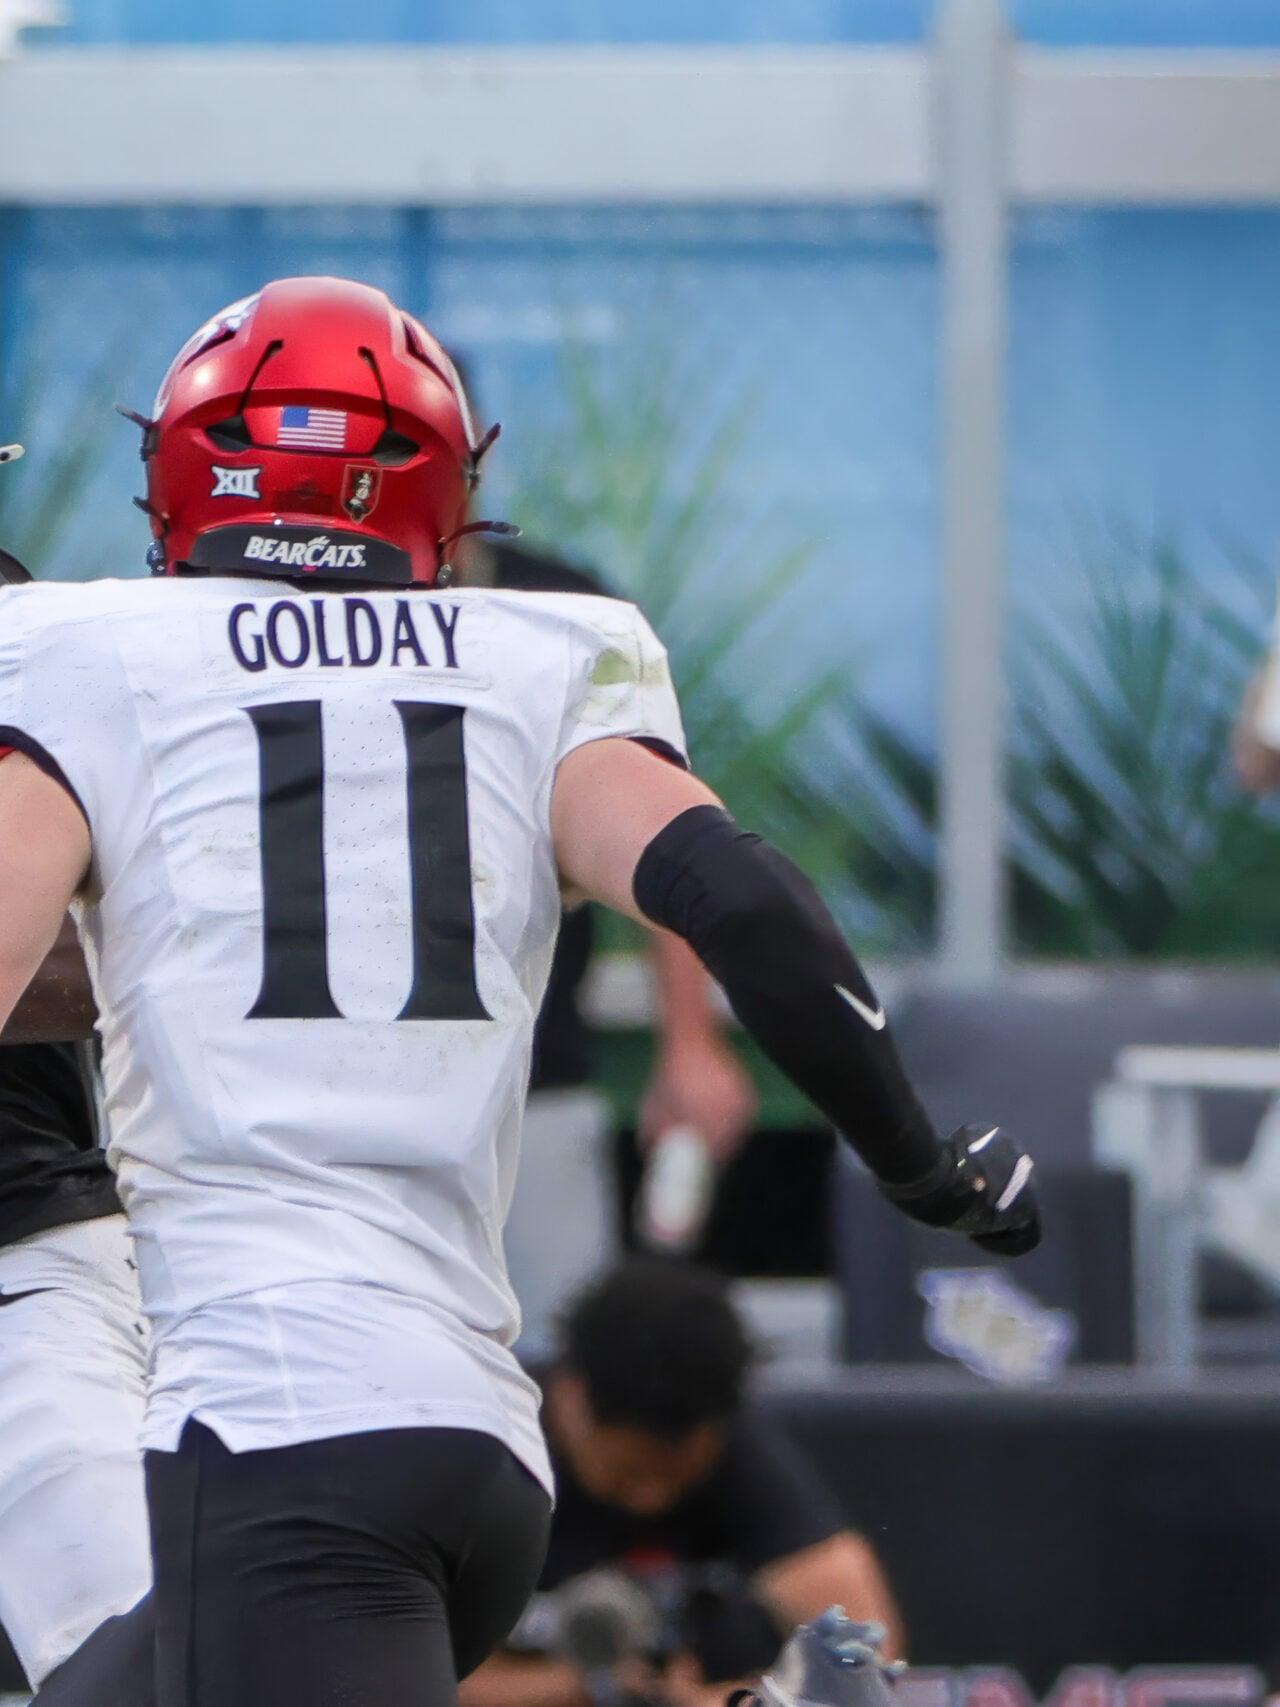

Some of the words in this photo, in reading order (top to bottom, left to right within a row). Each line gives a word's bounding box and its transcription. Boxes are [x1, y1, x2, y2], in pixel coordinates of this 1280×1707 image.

[211, 465, 261, 499] XII
[243, 535, 367, 569] BEARCATS
[228, 598, 461, 672] GOLDAY
[239, 699, 495, 1022] 11
